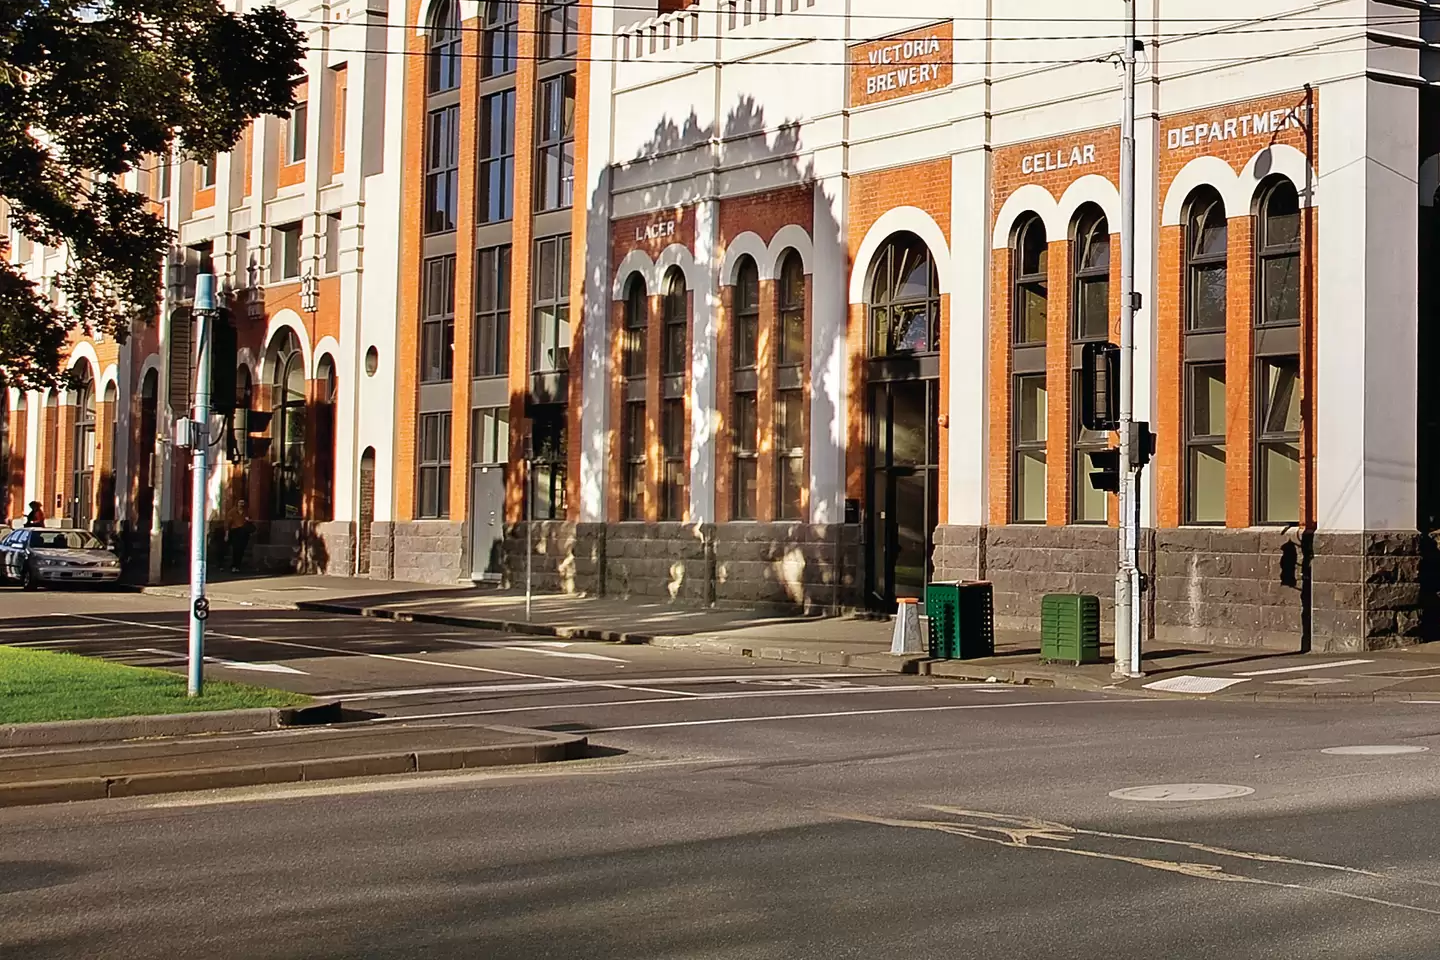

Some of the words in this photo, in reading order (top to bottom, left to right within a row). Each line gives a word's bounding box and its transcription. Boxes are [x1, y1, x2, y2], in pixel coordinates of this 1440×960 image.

[868, 35, 940, 68] VICTORIA
[866, 61, 942, 95] BREWERY
[1022, 144, 1096, 174] CELLAR
[1167, 103, 1314, 149] DEPARTMENT
[635, 220, 675, 241] LAGER
